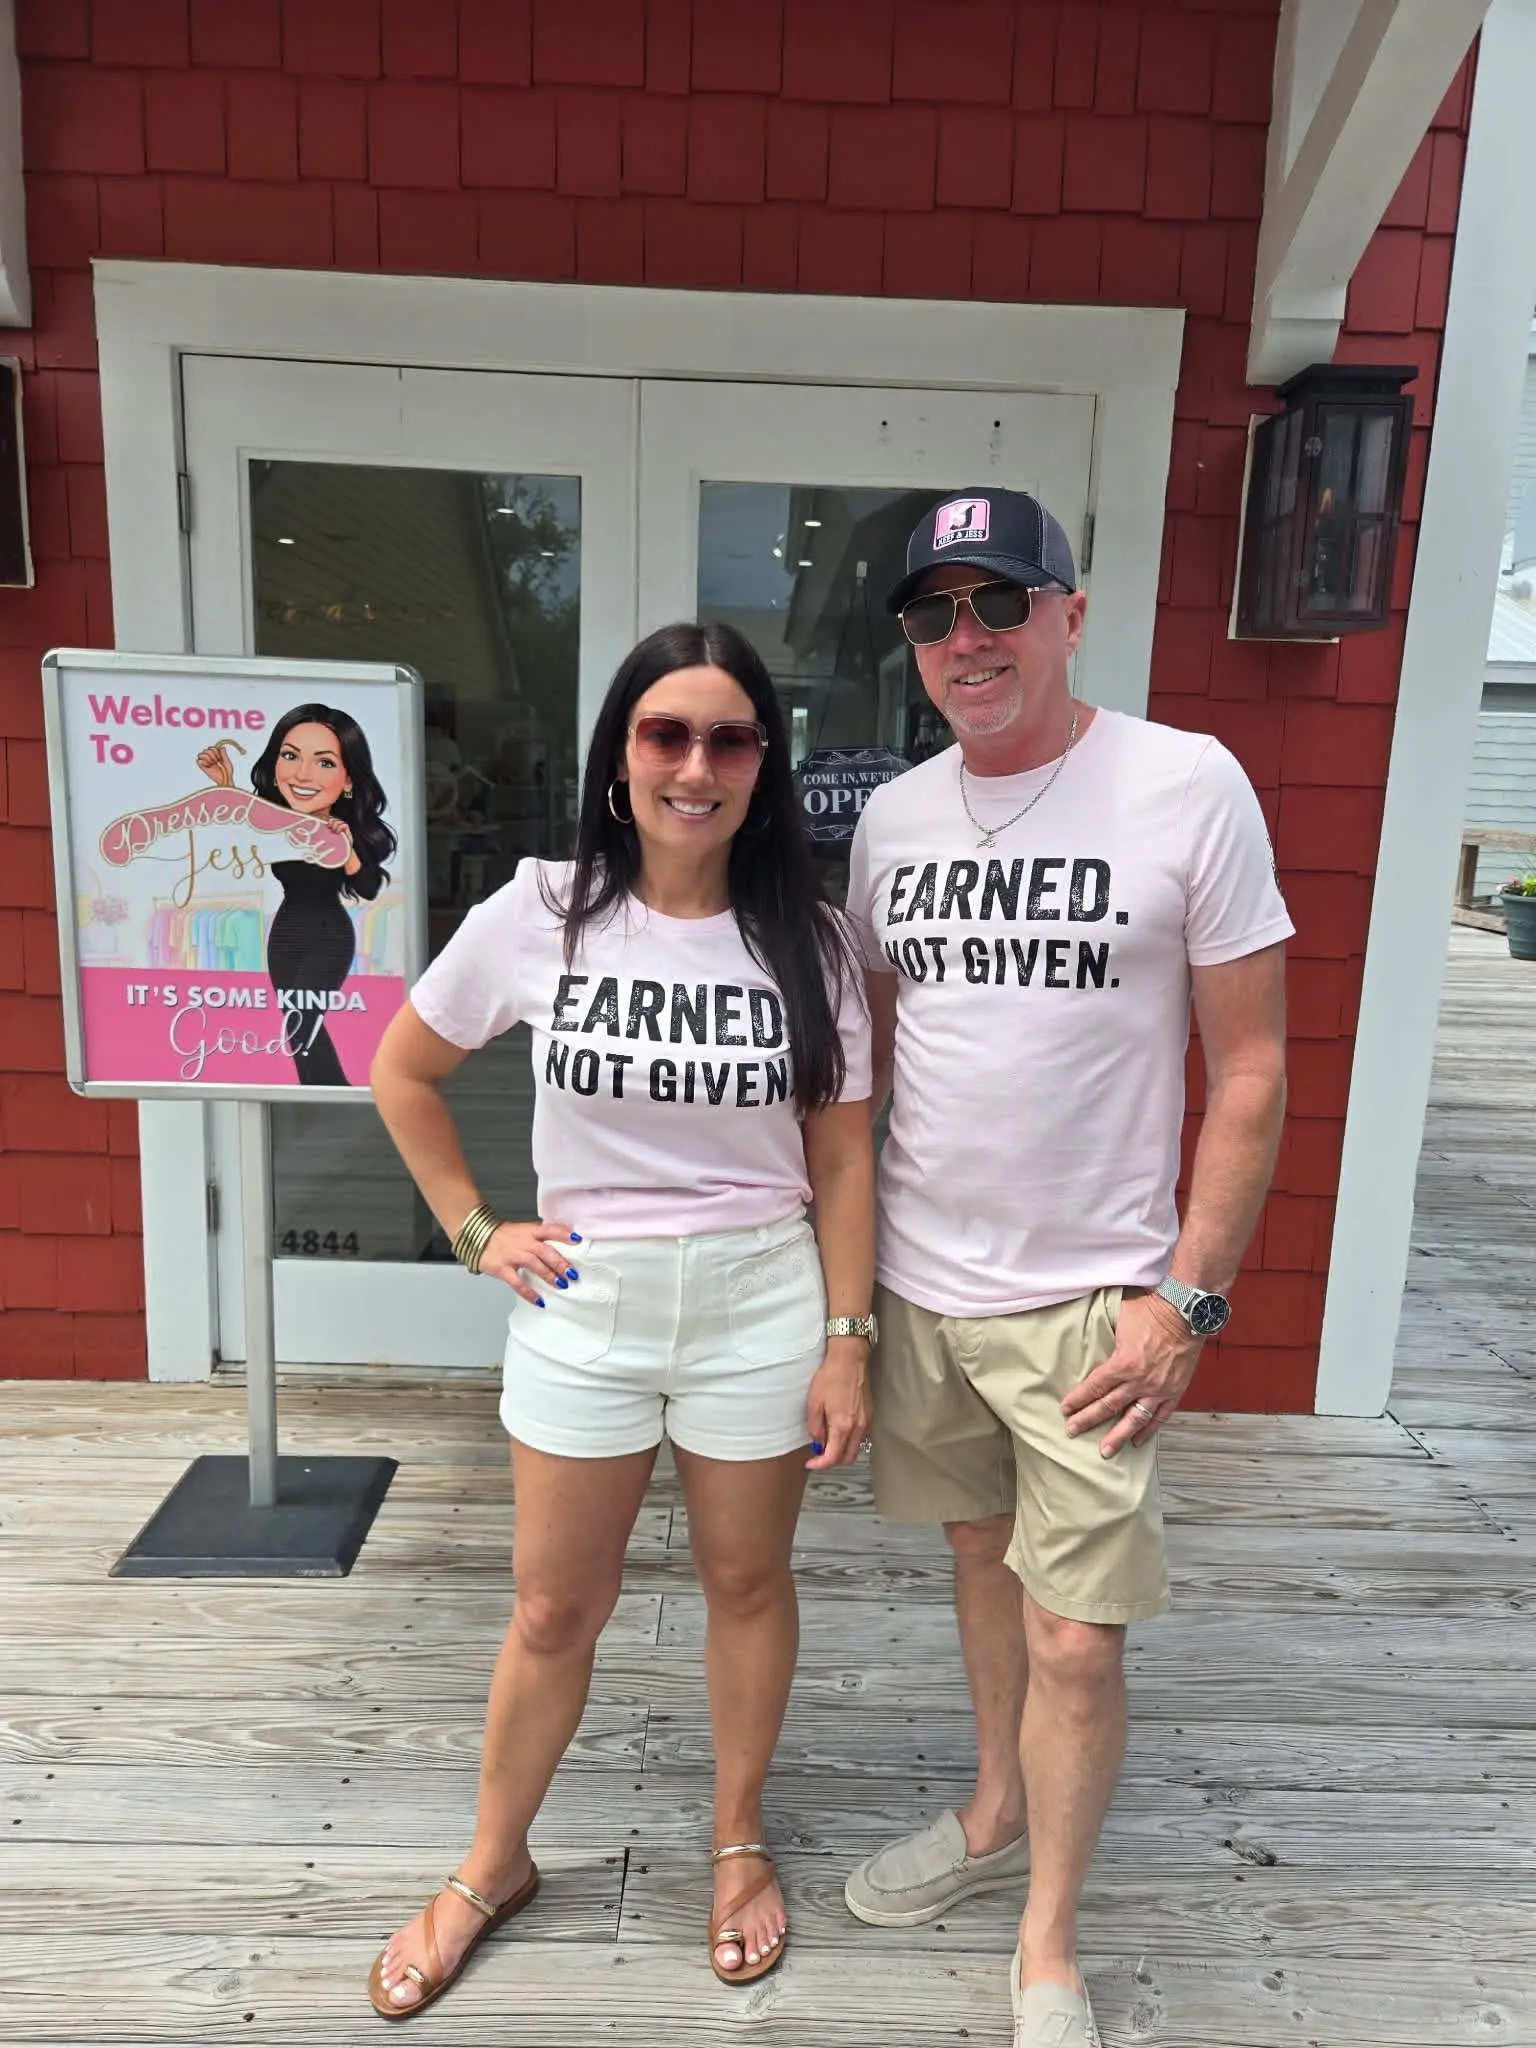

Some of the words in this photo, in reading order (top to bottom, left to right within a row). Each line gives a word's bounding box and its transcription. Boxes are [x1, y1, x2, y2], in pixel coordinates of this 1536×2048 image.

[964, 530, 983, 538] JESS
[88, 694, 266, 731] Welcome
[90, 734, 134, 765] To
[803, 774, 839, 785] COME
[803, 787, 873, 815] OPE
[112, 799, 255, 854] Dressed
[286, 815, 337, 862] By
[172, 829, 266, 908] Jess
[886, 857, 1129, 926] EARNED.
[885, 937, 948, 983] NOT
[962, 937, 1120, 989] GIVEN.
[126, 984, 178, 1007] IT'S
[188, 986, 267, 1009] SOME
[277, 989, 367, 1012] KINDA
[169, 1005, 324, 1081] Good!
[545, 1040, 634, 1099] NOT
[280, 1227, 360, 1255] 4844
